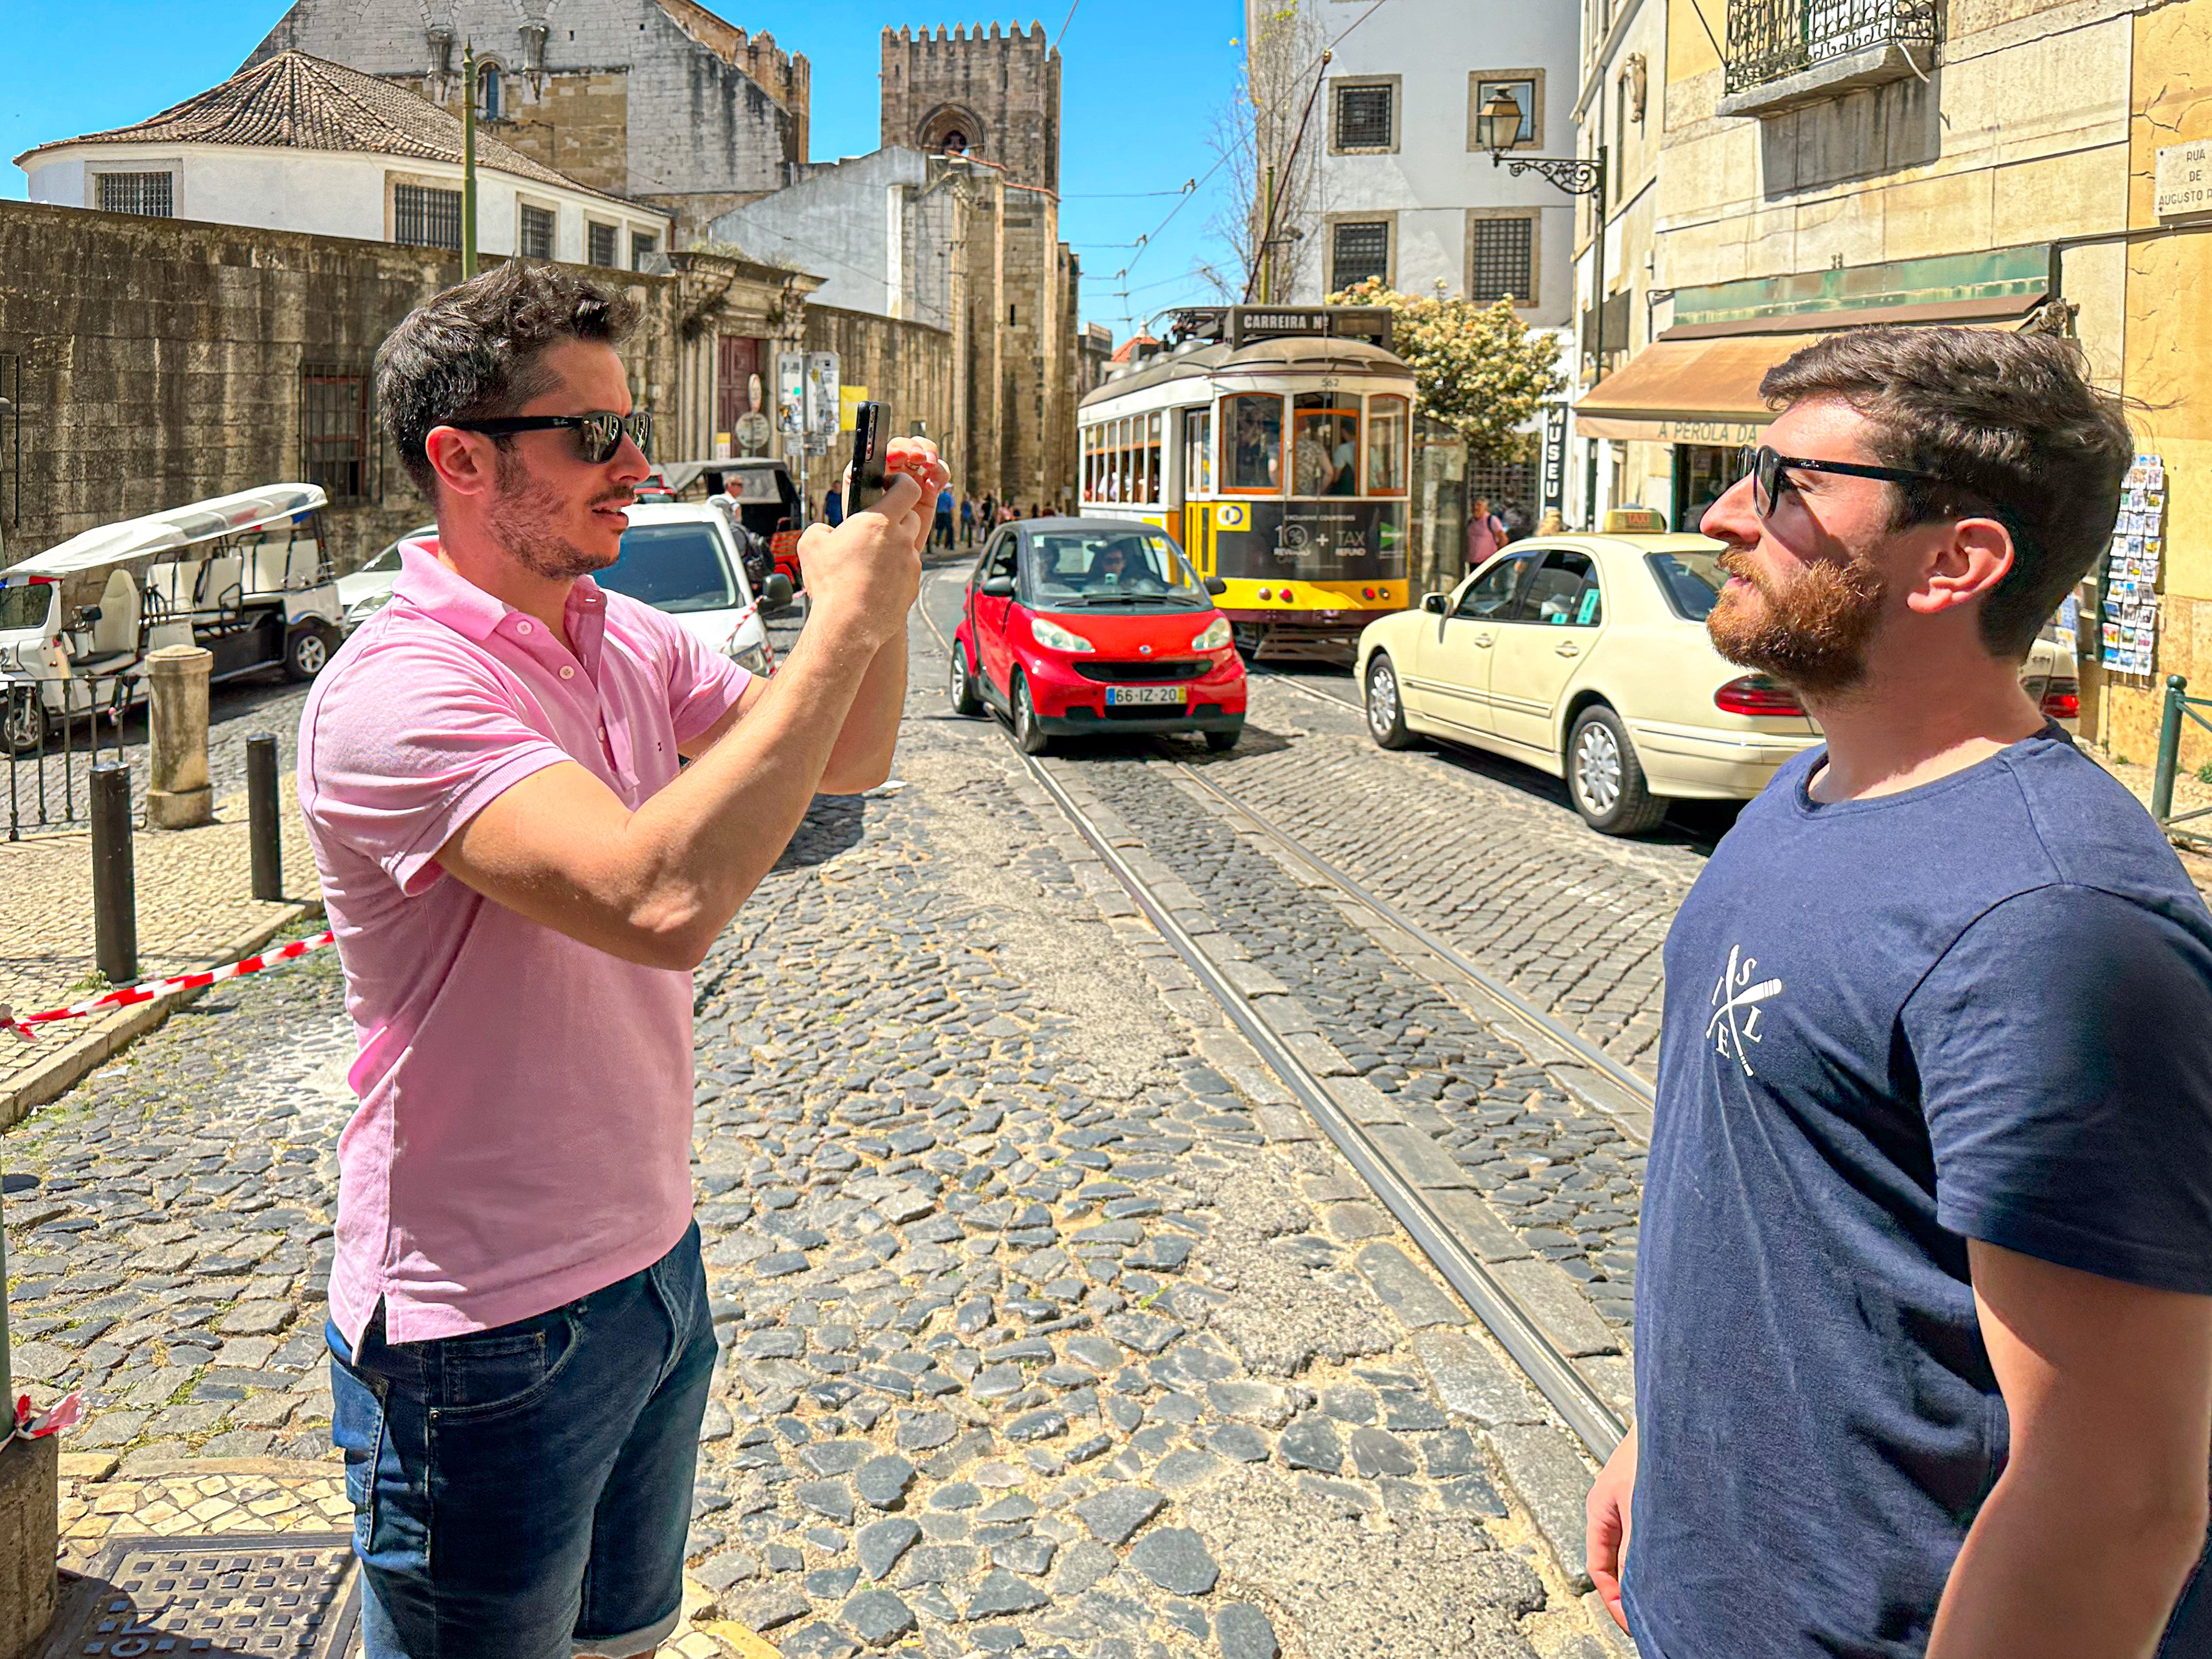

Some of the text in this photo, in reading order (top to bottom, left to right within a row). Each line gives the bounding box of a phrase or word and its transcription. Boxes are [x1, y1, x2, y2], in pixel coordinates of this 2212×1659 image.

[2187, 149, 2206, 162] RUA
[2190, 170, 2202, 182] DE
[2159, 190, 2203, 206] AUGUSTO
[1243, 314, 1307, 329] CARREIRA
[1658, 422, 1668, 439] A
[1546, 408, 1565, 498] MUSEU
[1627, 513, 1650, 524] TAXI
[1336, 530, 1366, 547] TAX
